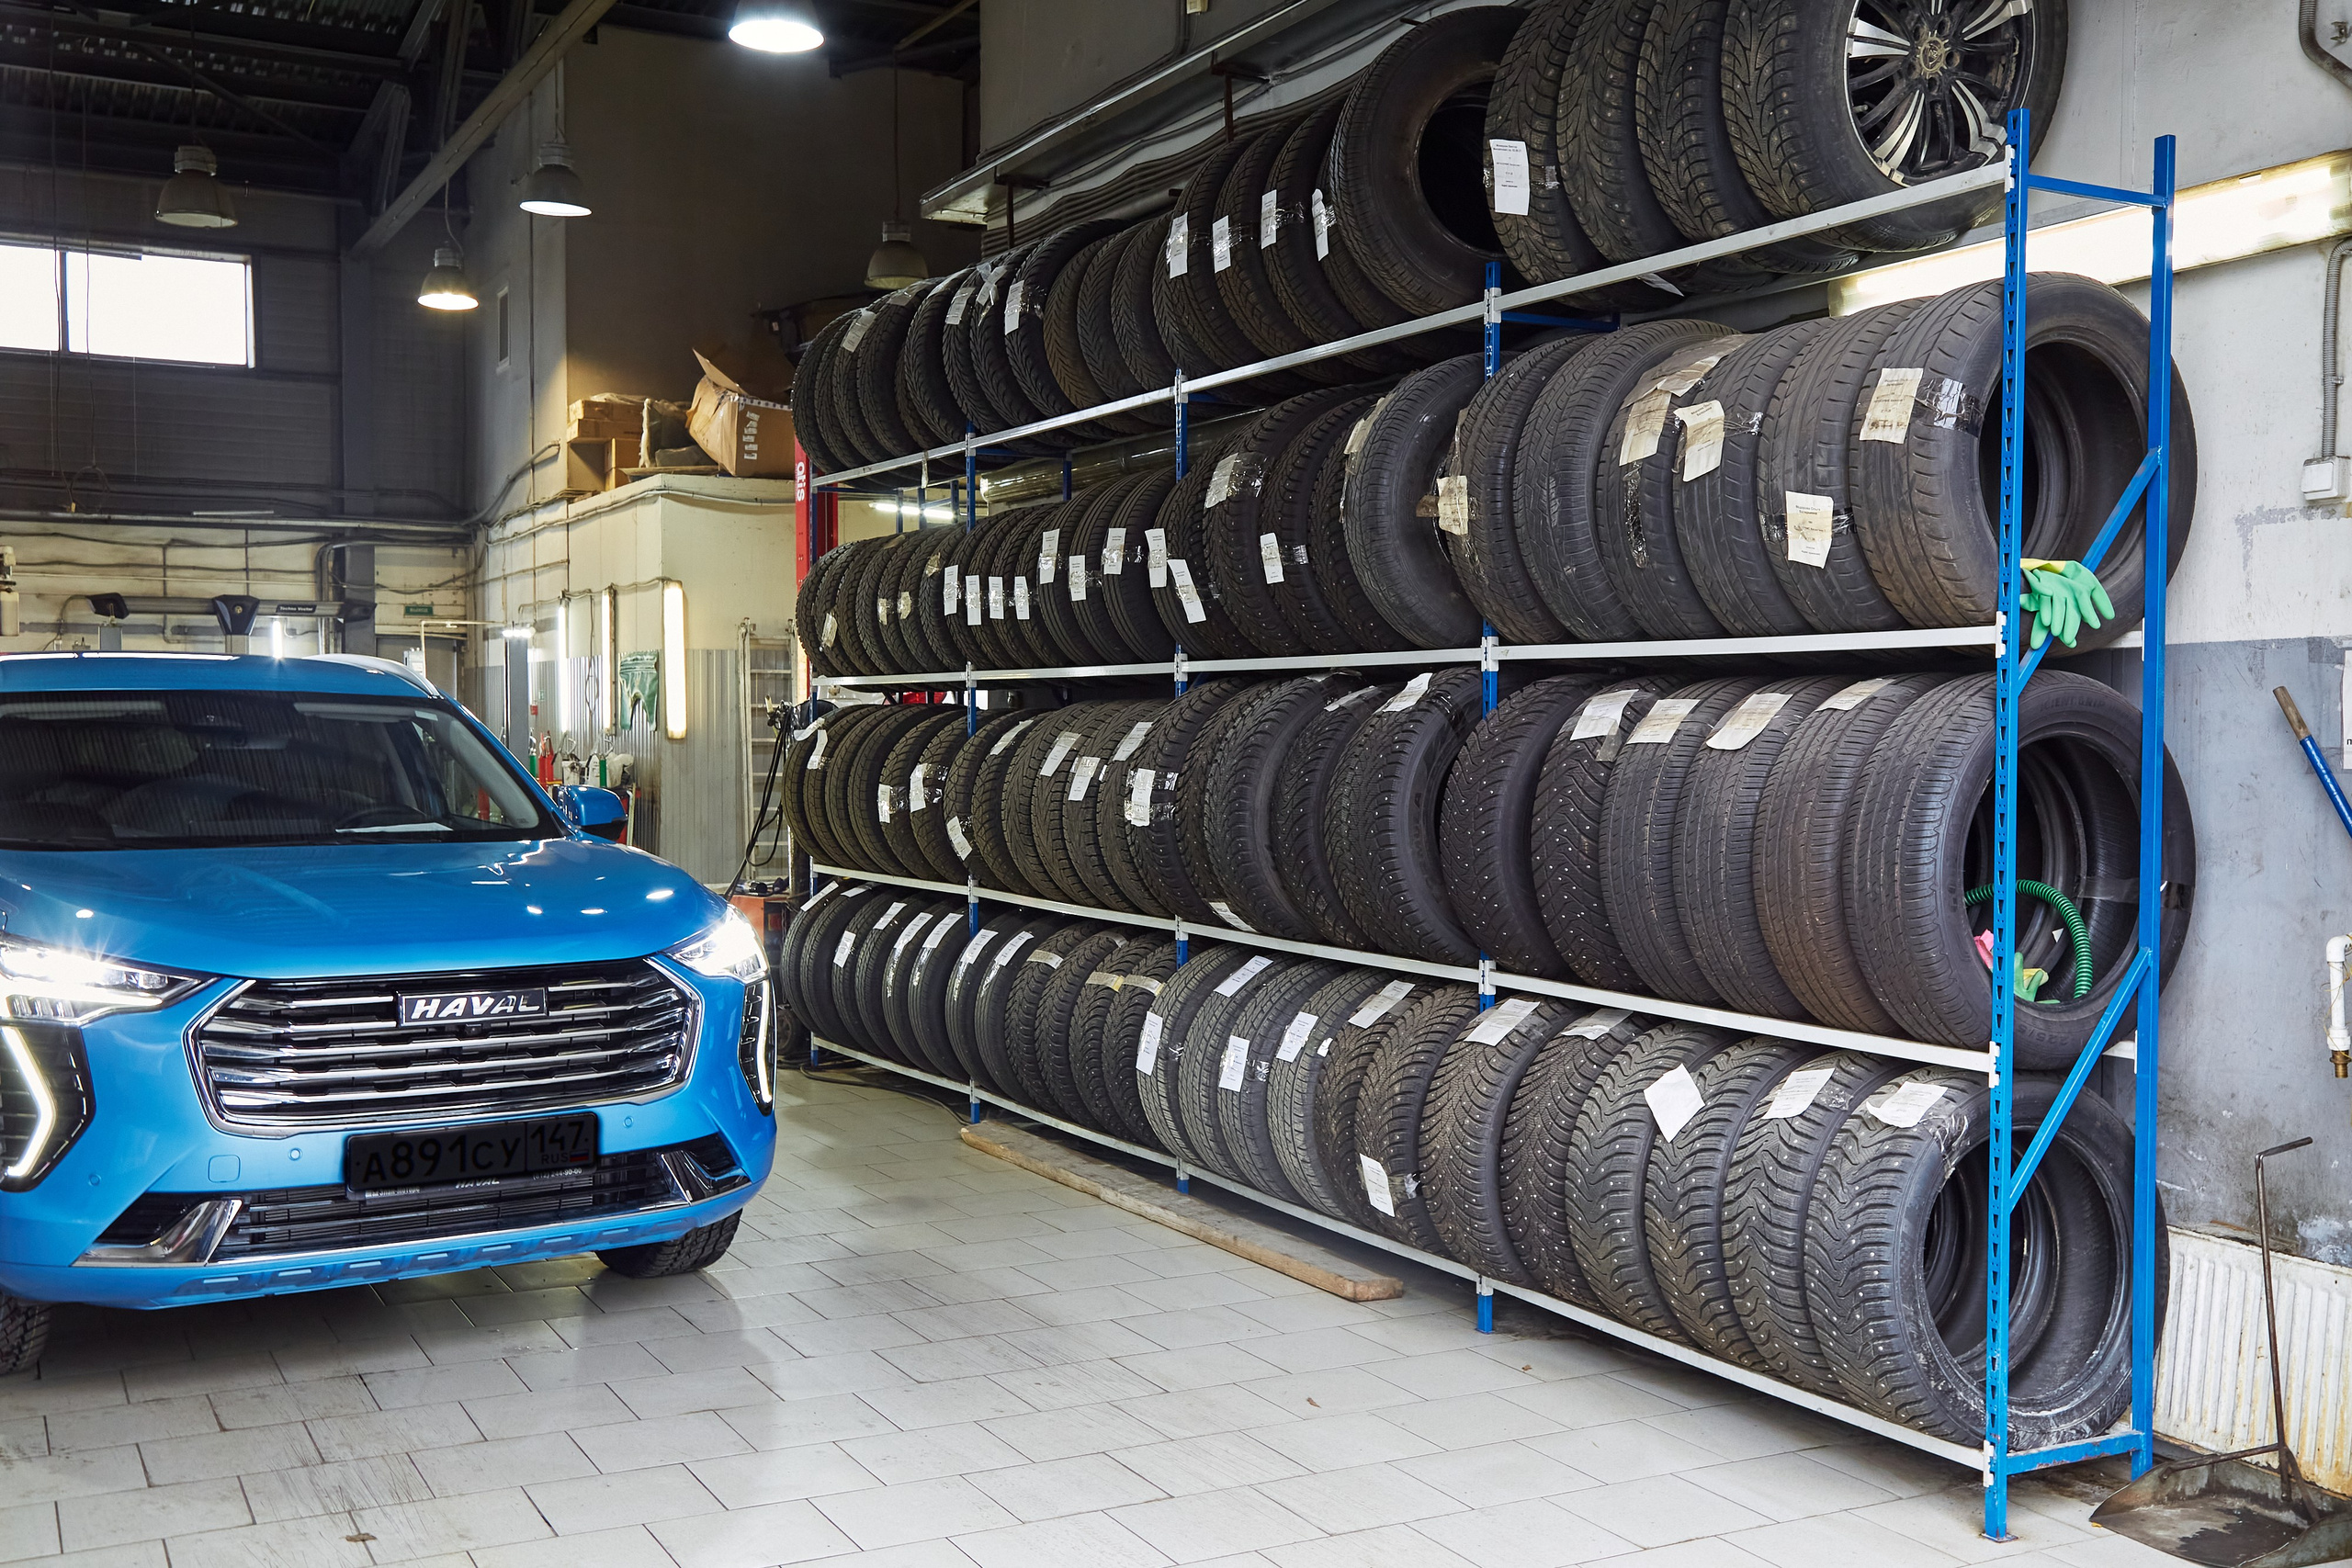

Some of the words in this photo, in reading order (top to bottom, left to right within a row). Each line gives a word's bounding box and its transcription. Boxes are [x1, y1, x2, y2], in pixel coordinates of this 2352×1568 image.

[797, 461, 806, 502] atis
[410, 994, 541, 1020] HAVAL
[530, 1121, 585, 1153] 147
[540, 1151, 570, 1165] RUS
